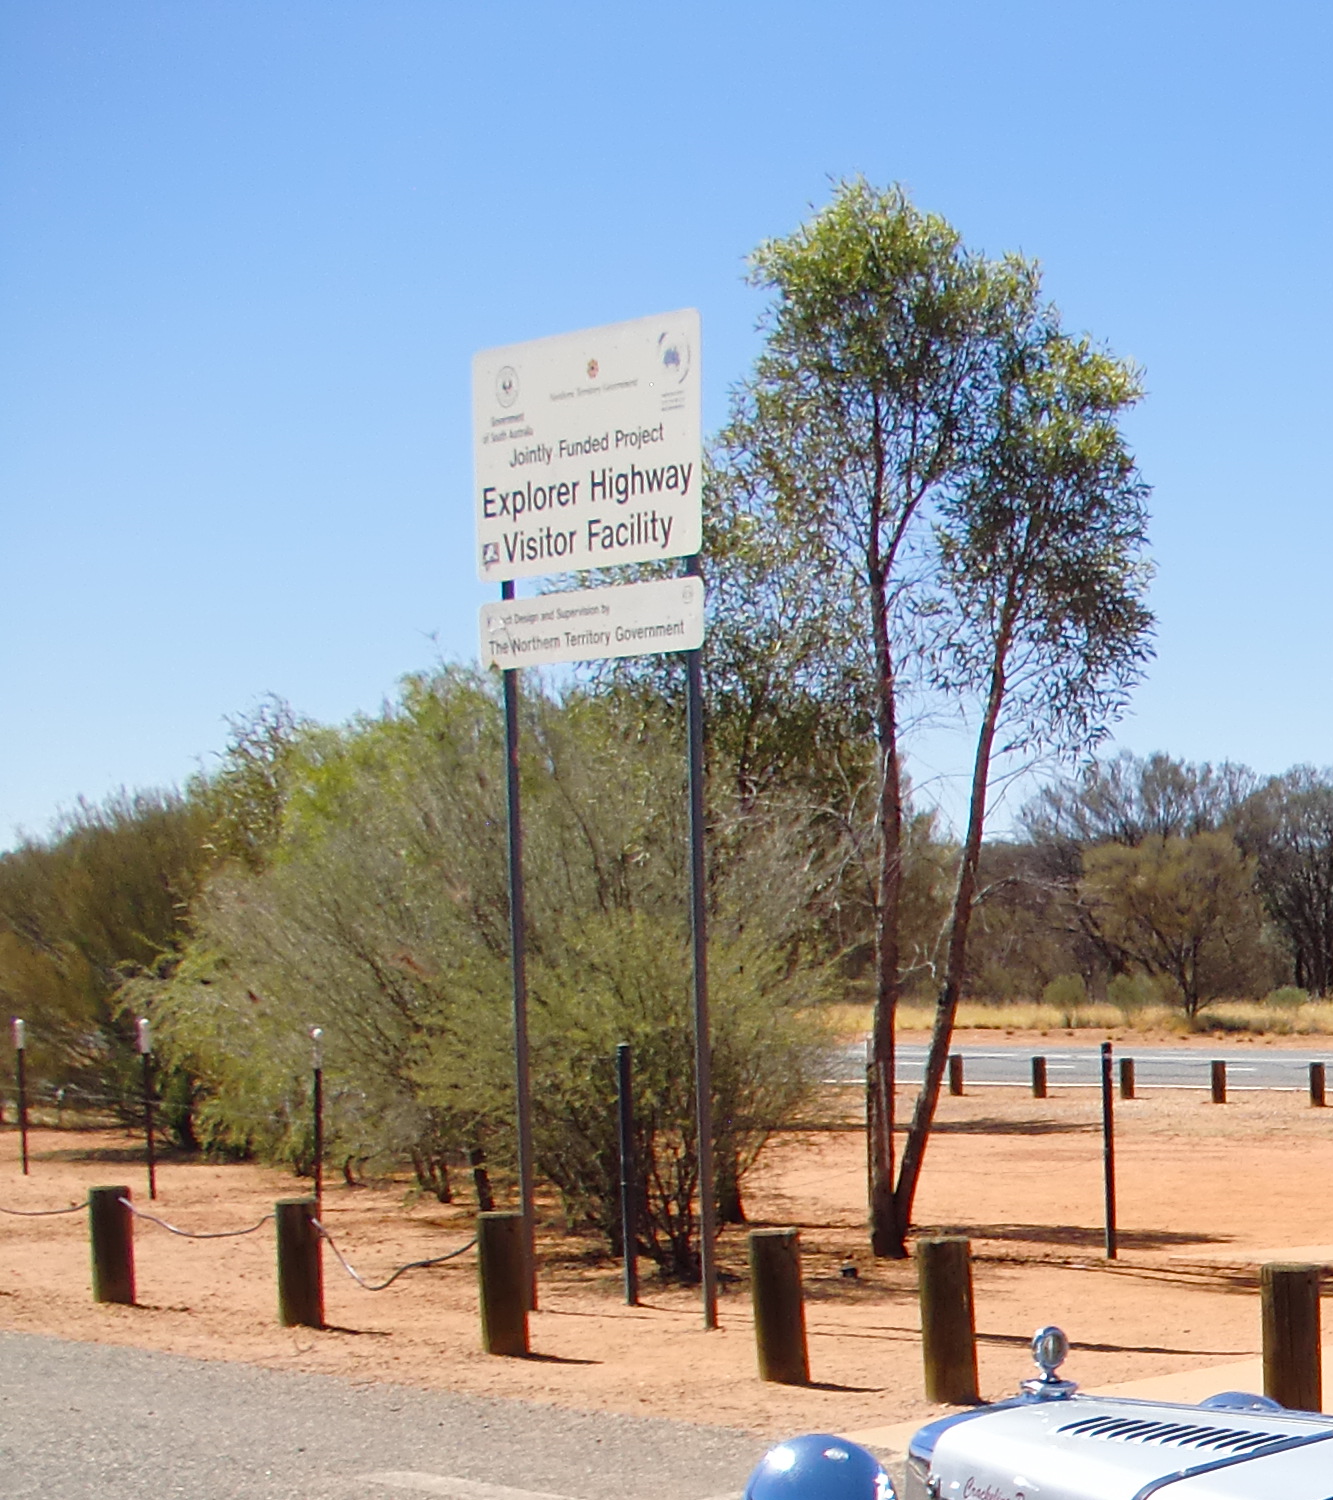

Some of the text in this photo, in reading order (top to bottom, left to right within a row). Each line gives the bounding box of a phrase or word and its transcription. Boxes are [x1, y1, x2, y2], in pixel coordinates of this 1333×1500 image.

[510, 422, 664, 468] Jointly Funded Project
[482, 462, 693, 522] Explorer Highway
[503, 510, 673, 563] Visitor Facility
[489, 620, 685, 656] The Northern Territory Government
